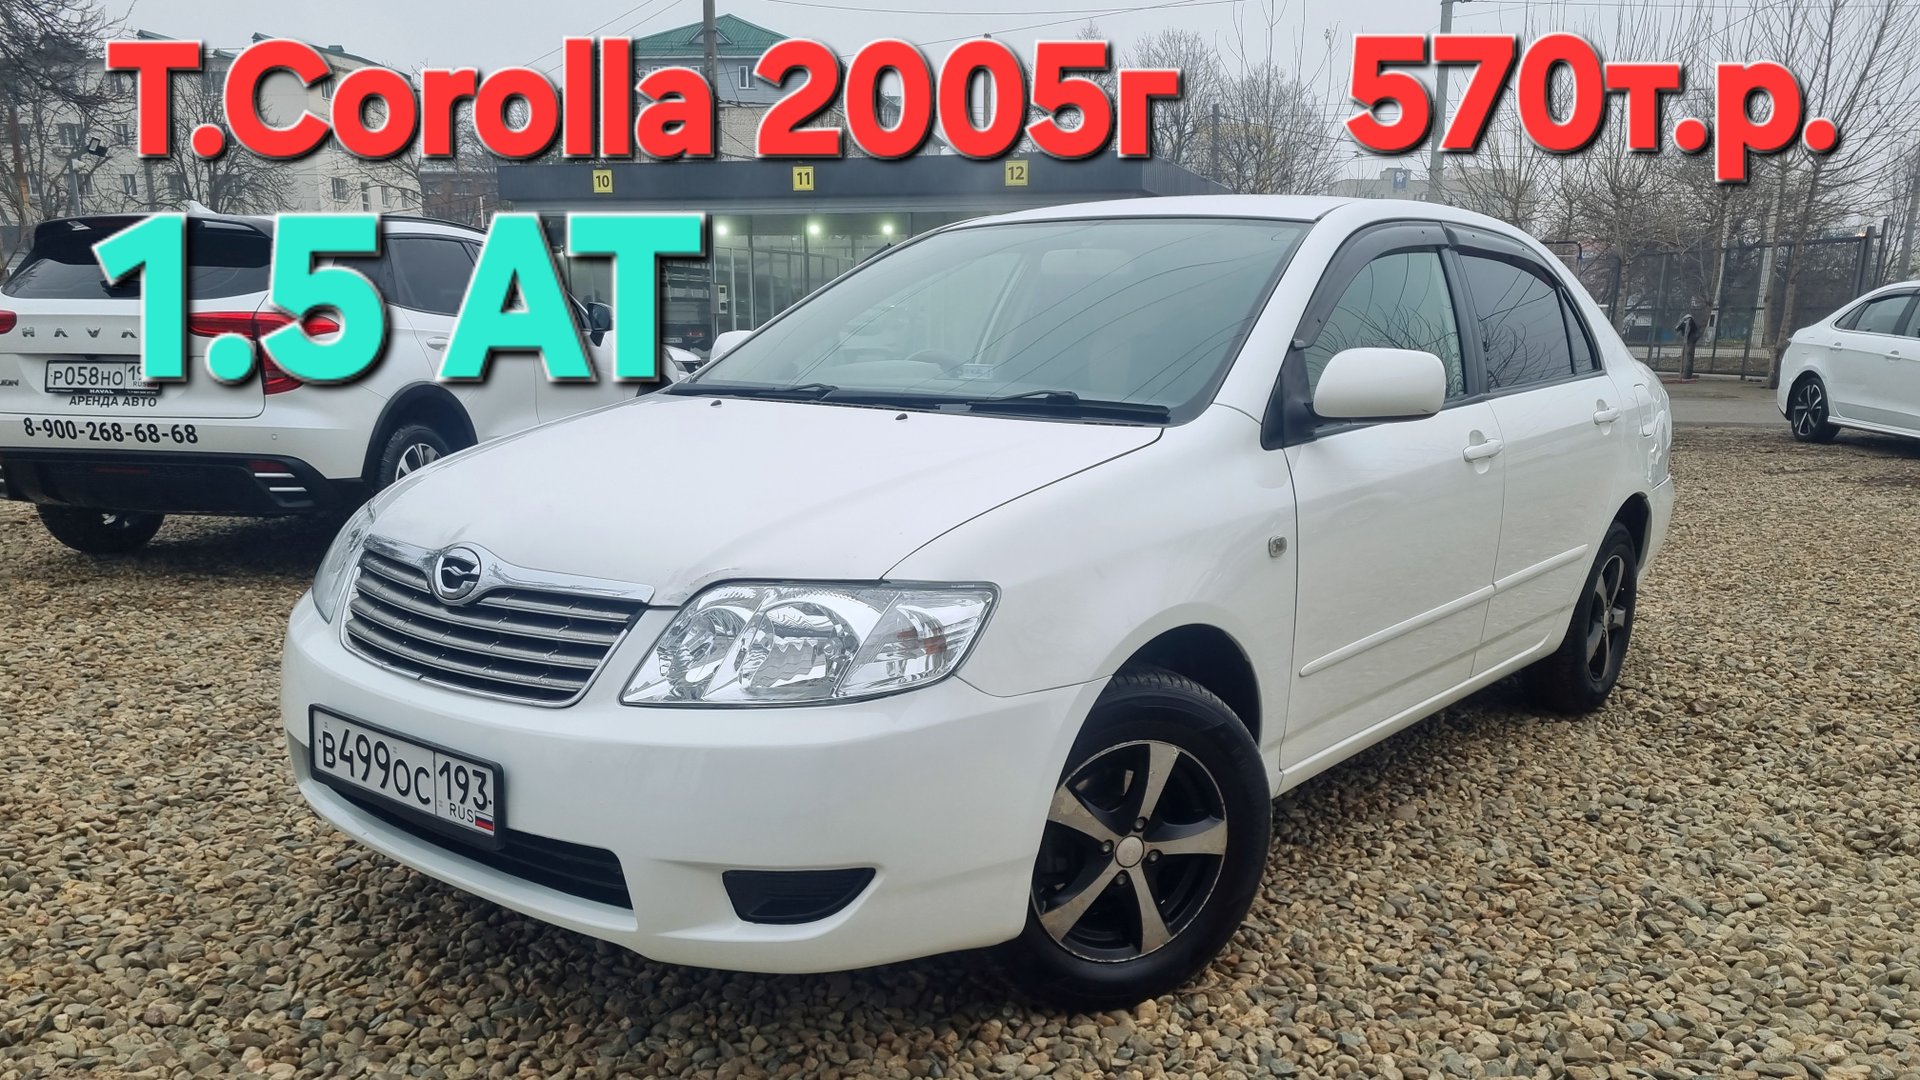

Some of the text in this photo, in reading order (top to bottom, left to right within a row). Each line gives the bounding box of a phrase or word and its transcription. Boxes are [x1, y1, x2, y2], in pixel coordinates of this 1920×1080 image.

[796, 171, 811, 186] 11
[1008, 165, 1025, 181] 12
[595, 174, 610, 188] 10
[22, 326, 138, 339] HAVA
[69, 395, 158, 408] АРЕНДА АВТО
[23, 416, 199, 444] 8-900-268-68-68
[438, 760, 488, 811] 193
[449, 802, 474, 823] RUS
